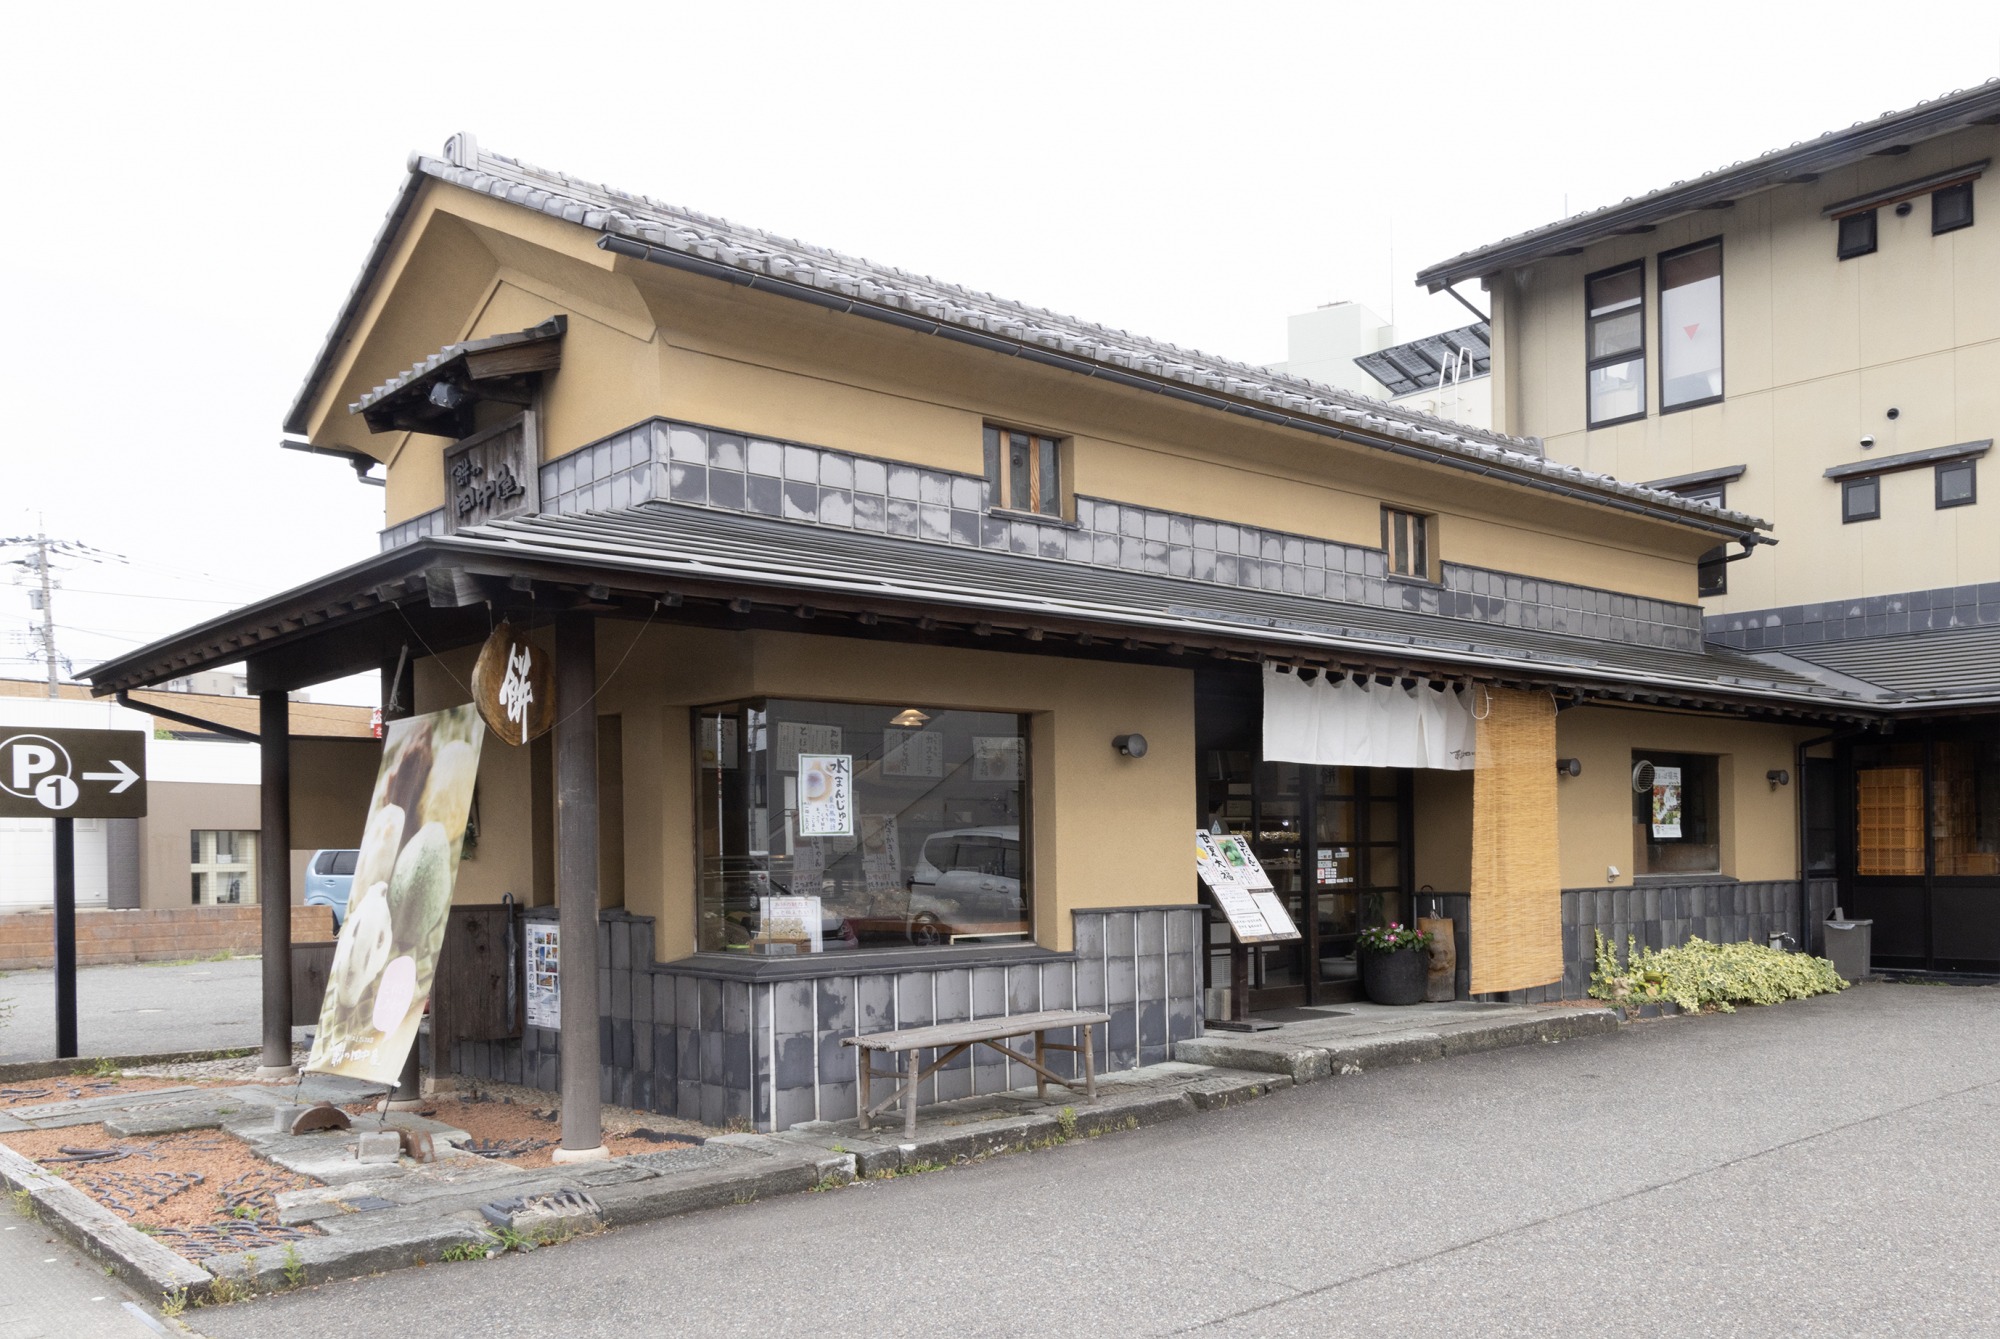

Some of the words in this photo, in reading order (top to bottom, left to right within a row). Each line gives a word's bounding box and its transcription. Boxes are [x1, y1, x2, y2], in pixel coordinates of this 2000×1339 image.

[456, 464, 526, 518] 田中屋
[12, 744, 56, 789] P
[46, 778, 62, 806] 1
[830, 758, 849, 831] 水まんじゅう
[1199, 832, 1234, 881] 甘夏大福
